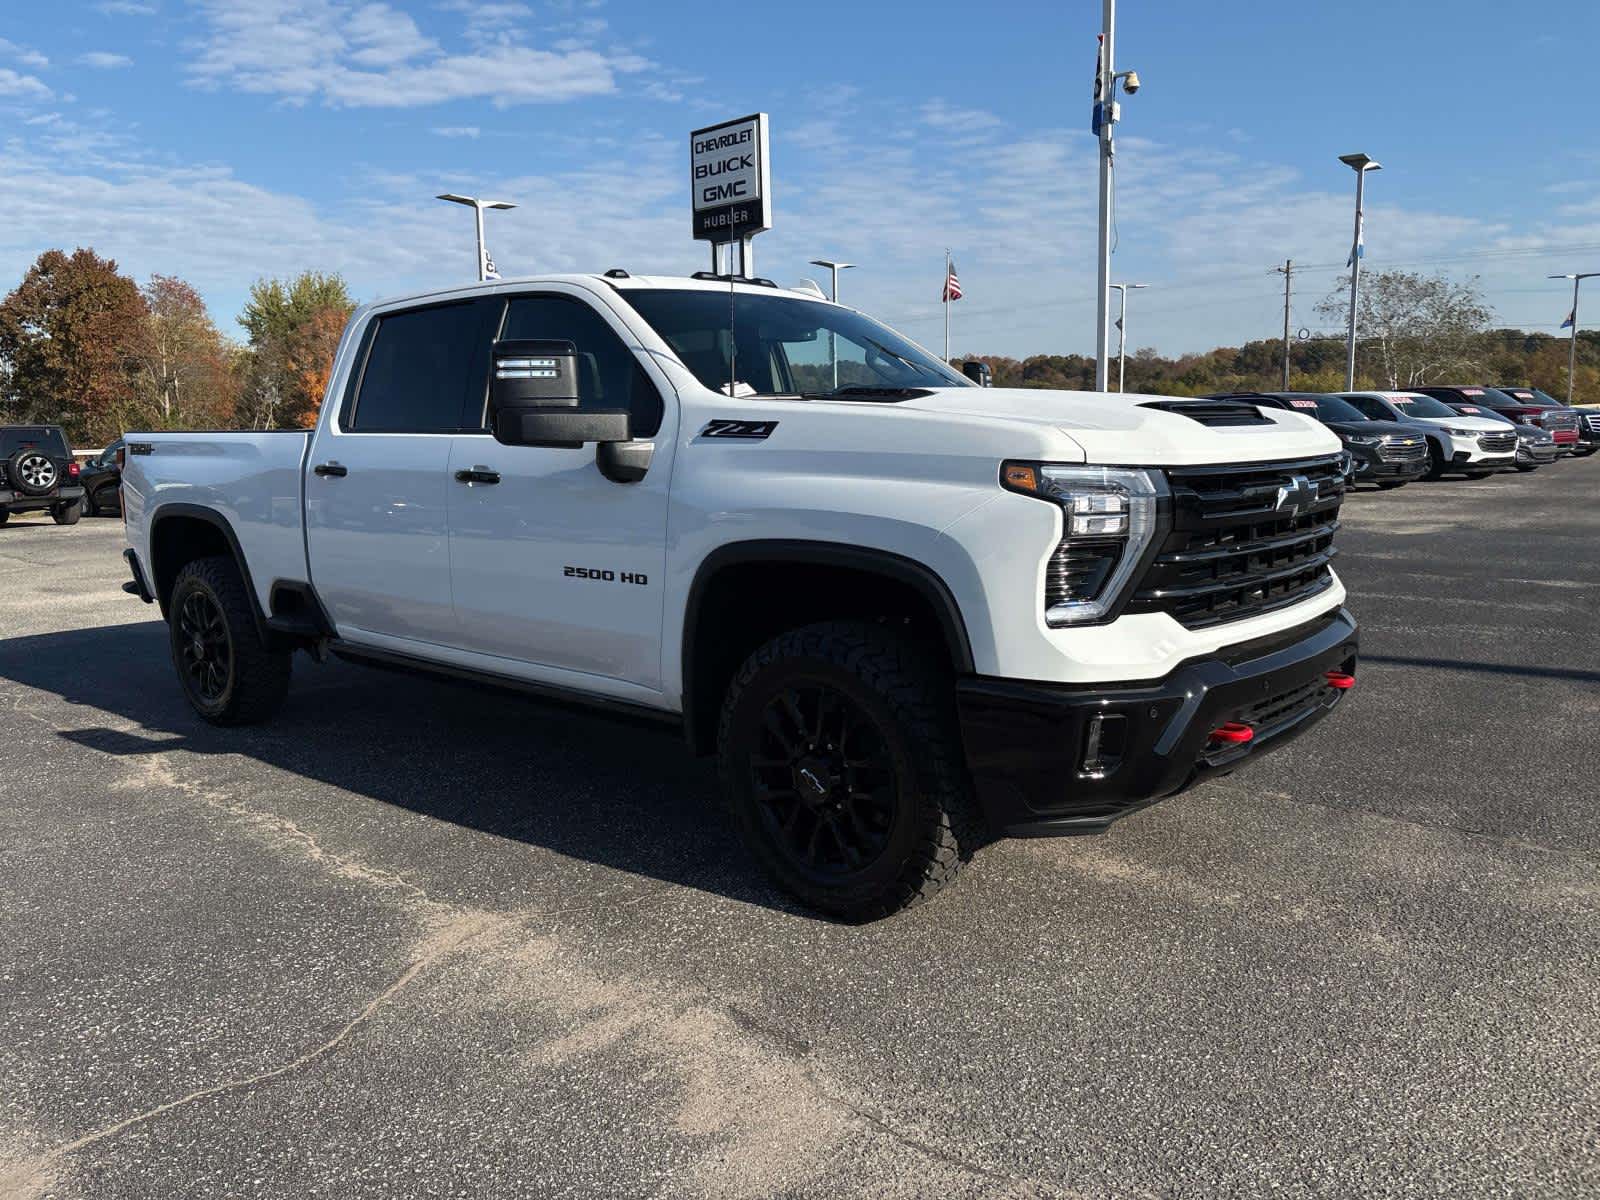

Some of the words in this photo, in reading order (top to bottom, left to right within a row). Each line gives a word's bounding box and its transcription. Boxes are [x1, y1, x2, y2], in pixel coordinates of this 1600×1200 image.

[695, 129, 752, 154] CHEVROLET
[695, 153, 753, 179] BUICK
[703, 180, 747, 202] GMC
[703, 210, 748, 228] HUBLER
[563, 566, 615, 581] 2500
[620, 572, 648, 585] HD
